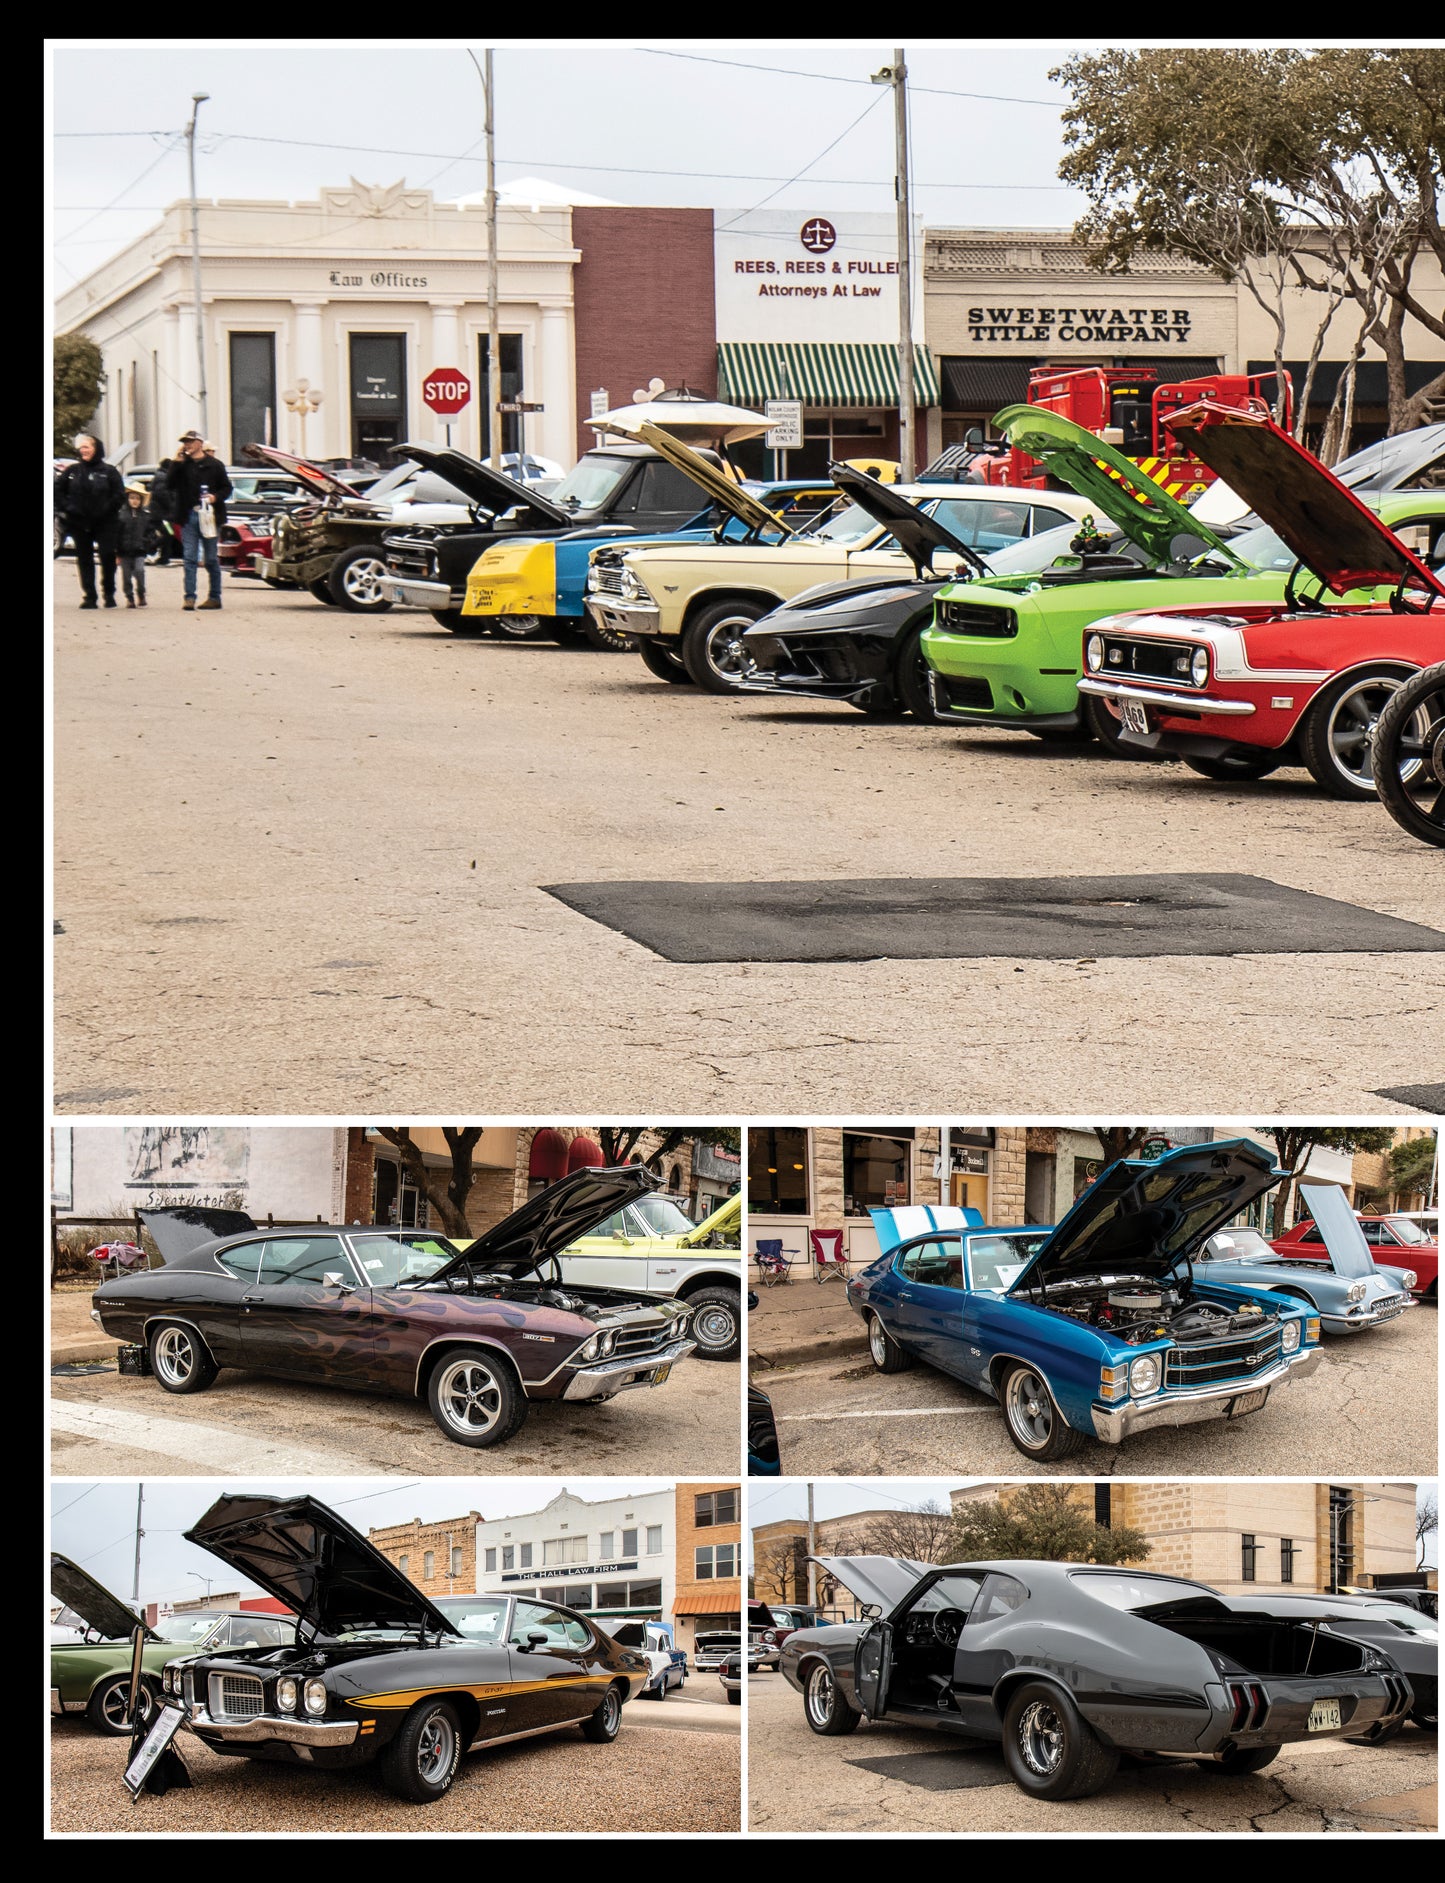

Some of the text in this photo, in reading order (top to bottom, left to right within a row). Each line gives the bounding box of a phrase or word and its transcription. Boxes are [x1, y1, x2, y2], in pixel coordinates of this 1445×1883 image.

[734, 261, 780, 275] REES,
[785, 261, 826, 274] REES
[831, 261, 842, 274] &
[329, 271, 427, 287] Law Offices
[758, 283, 881, 299] Attorneys At Law
[968, 308, 1191, 325] SWEETWATER
[968, 326, 1191, 342] TITLE COMPANY
[425, 382, 469, 400] STOP
[499, 403, 521, 412] THIRD
[970, 1347, 981, 1357] SS
[1245, 1352, 1263, 1365] SS
[450, 1731, 460, 1776] AVENGER
